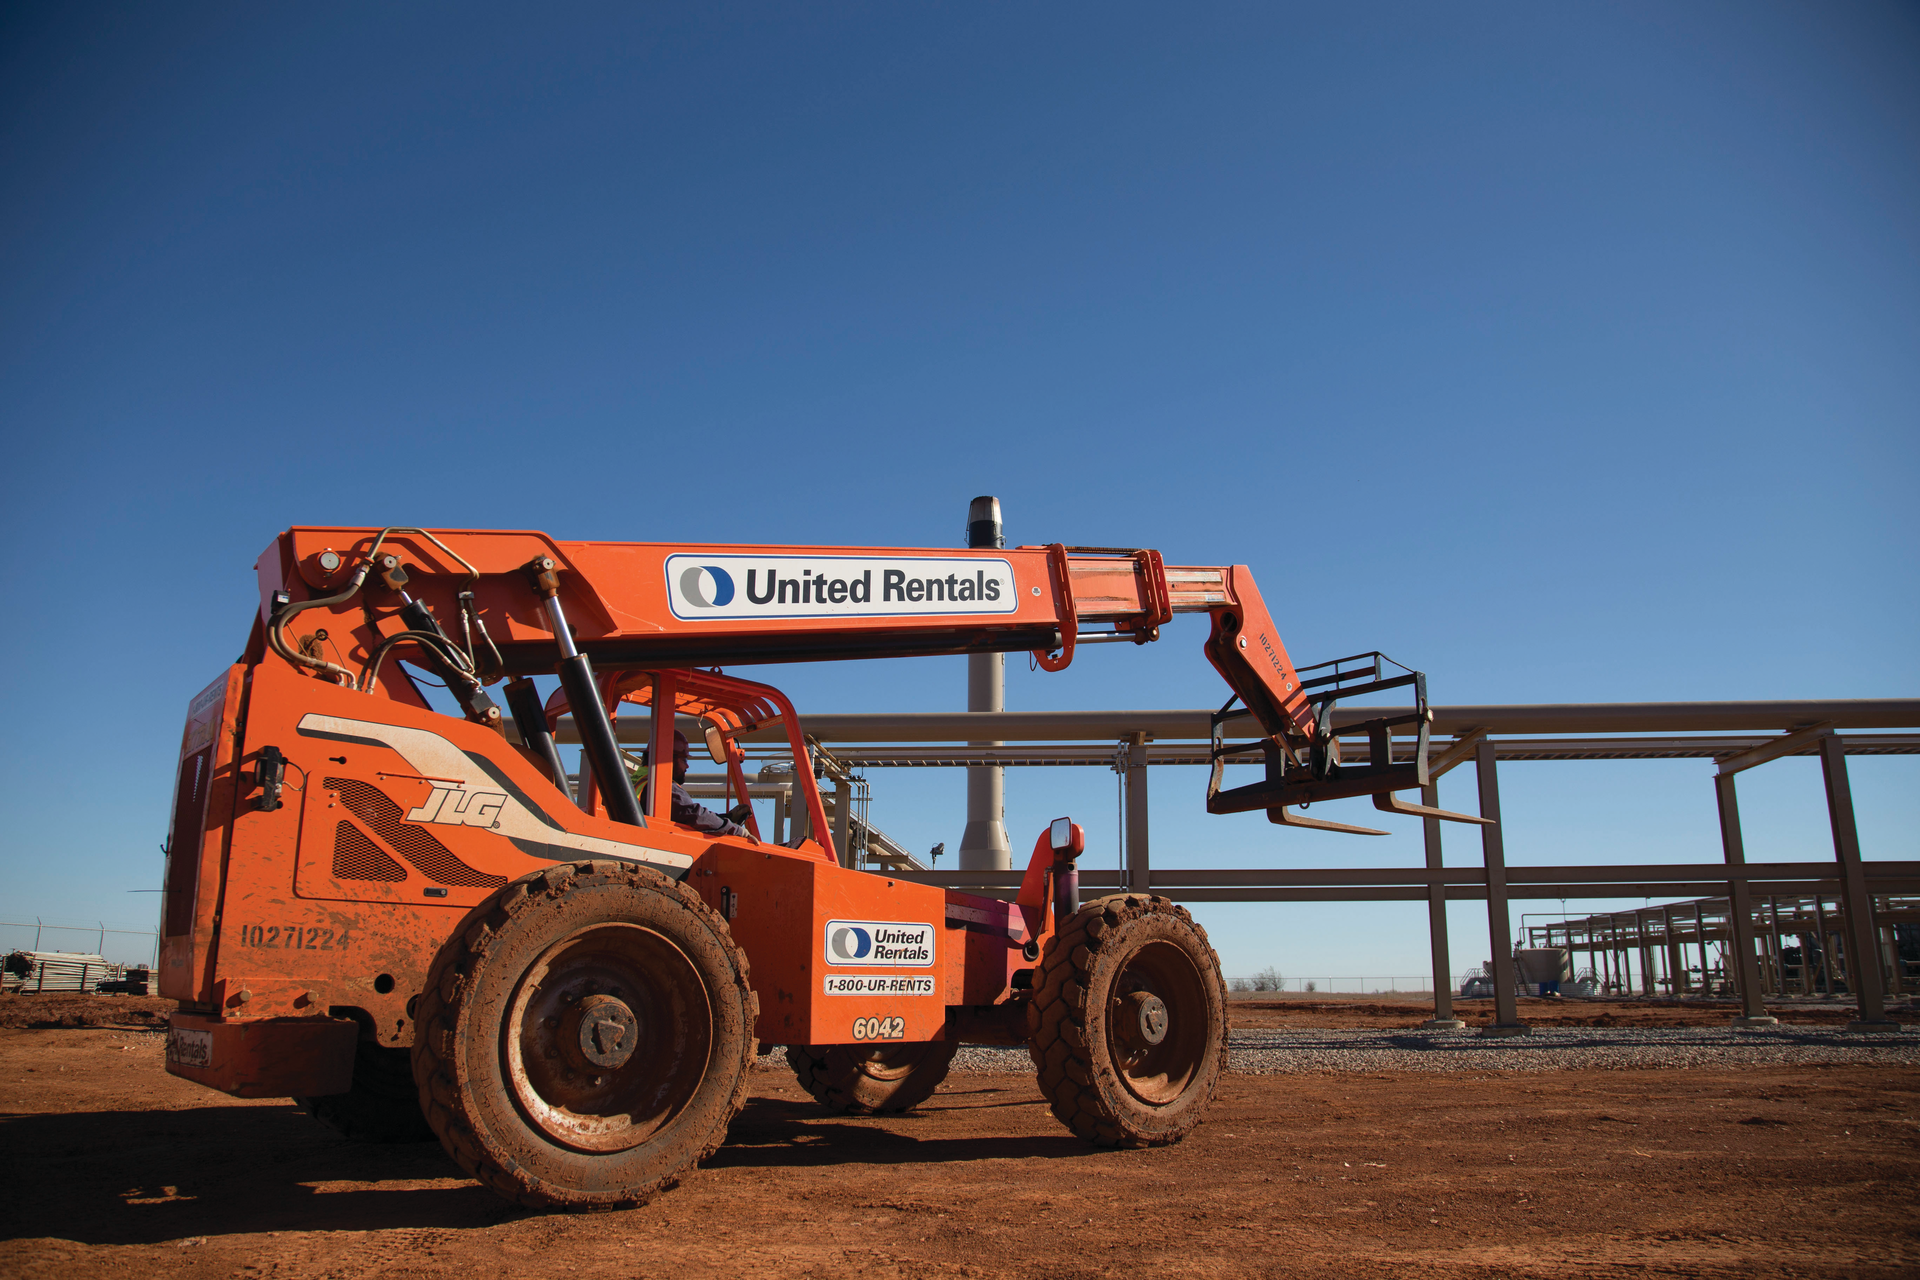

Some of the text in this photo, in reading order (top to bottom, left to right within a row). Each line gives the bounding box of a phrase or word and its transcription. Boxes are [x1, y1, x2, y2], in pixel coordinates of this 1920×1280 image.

[746, 569, 1001, 605] United Rentals
[1259, 632, 1287, 680] 10271224
[405, 787, 508, 829] JLG
[240, 924, 350, 951] 10271224
[874, 929, 925, 944] United
[874, 945, 929, 960] Rentals
[827, 979, 932, 992] 1-800-UR-RENTS
[852, 1016, 905, 1041] 6042
[180, 1036, 208, 1060] Rentals
